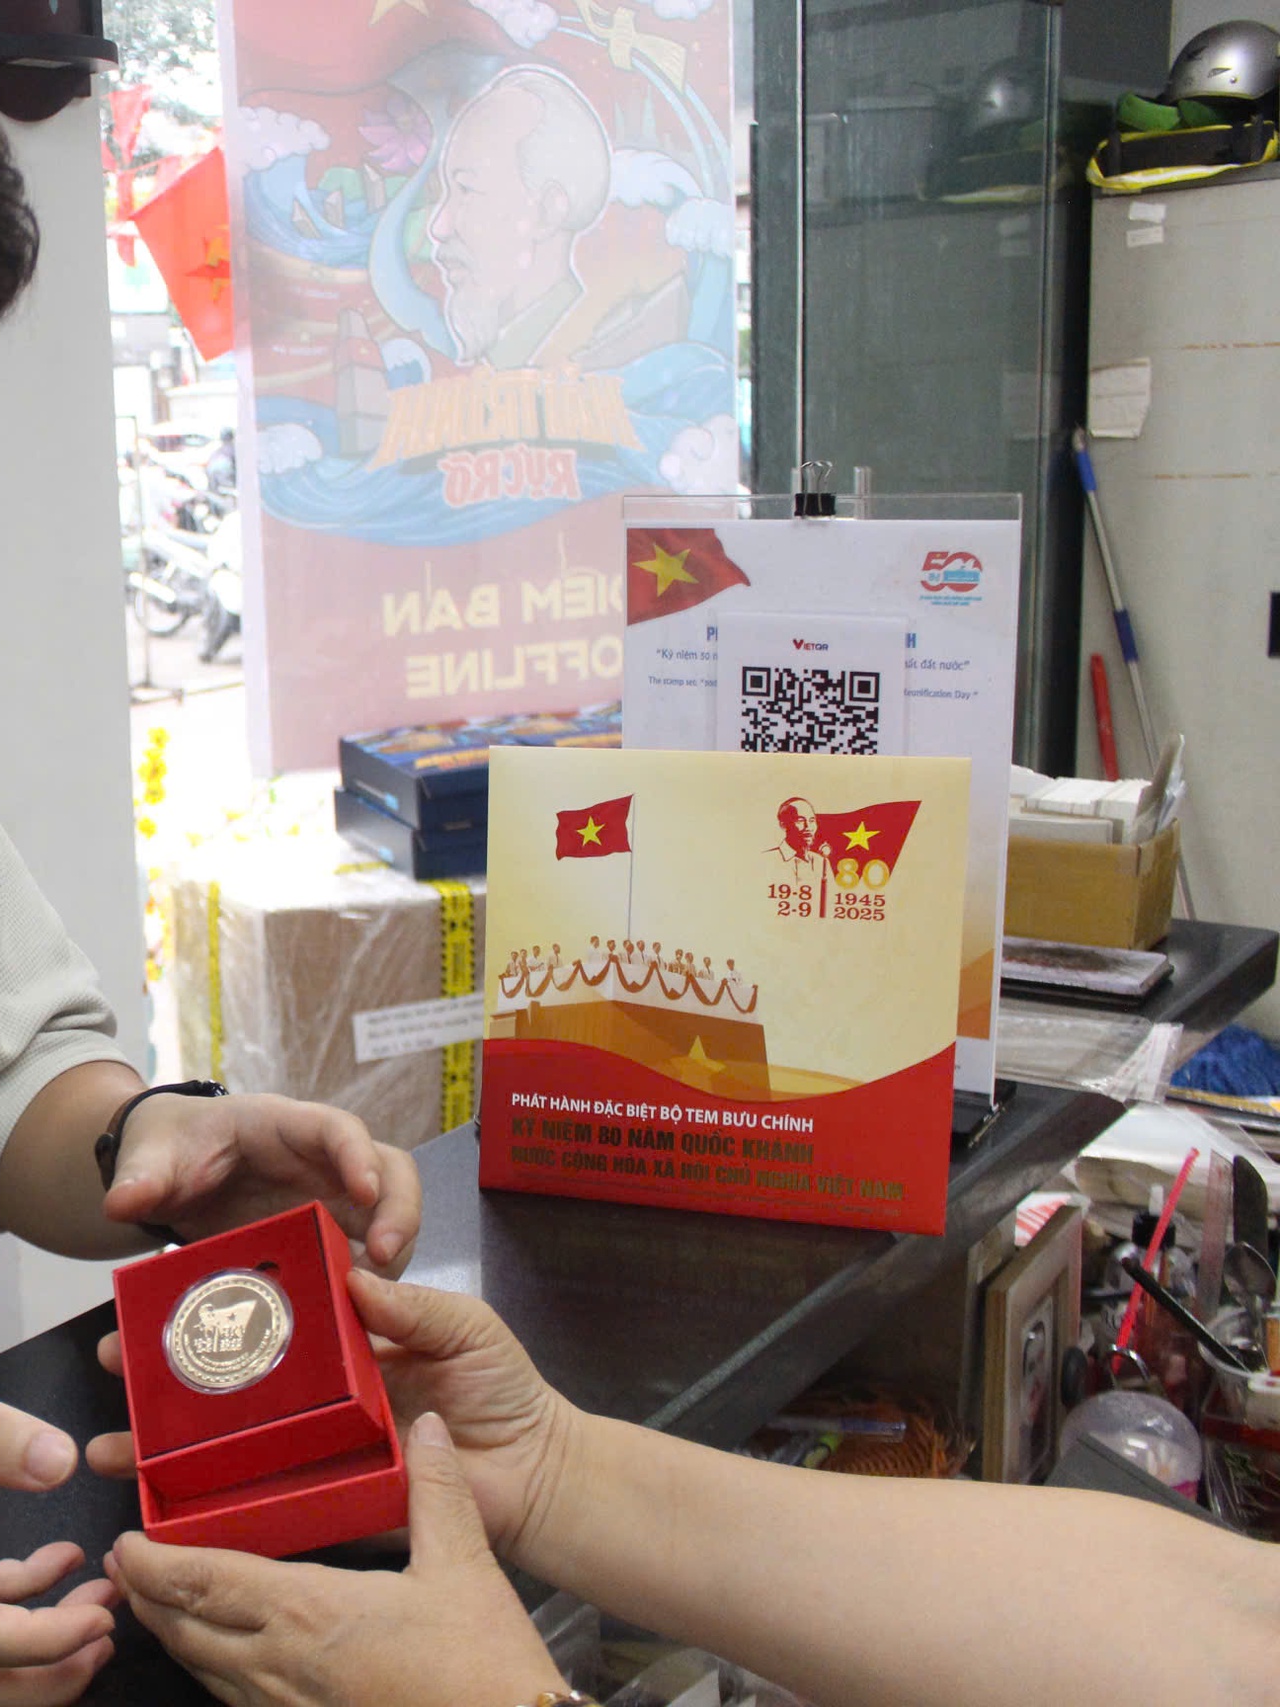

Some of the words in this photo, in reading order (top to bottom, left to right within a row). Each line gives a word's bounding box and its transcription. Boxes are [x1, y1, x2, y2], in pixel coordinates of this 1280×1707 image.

[834, 857, 891, 890] 80
[767, 884, 812, 900] 19-8
[834, 892, 886, 907] 1945
[777, 901, 812, 918] 2-9
[833, 906, 886, 921] 2025
[511, 1092, 547, 1109] PHÁT
[549, 1095, 590, 1113] HÀNH
[593, 1099, 623, 1118] ĐẶC
[626, 1102, 657, 1121] BIỆT
[660, 1104, 683, 1125] BỘ
[685, 1108, 718, 1124] TEM
[722, 1111, 757, 1128] BƯU
[761, 1113, 814, 1133] CHÍNH
[541, 1117, 592, 1144] NIỆM
[681, 1129, 735, 1156] QUỐC
[742, 1134, 814, 1164] KHÁNH
[817, 1174, 855, 1199] VIỆT
[860, 1179, 904, 1201] NAM
